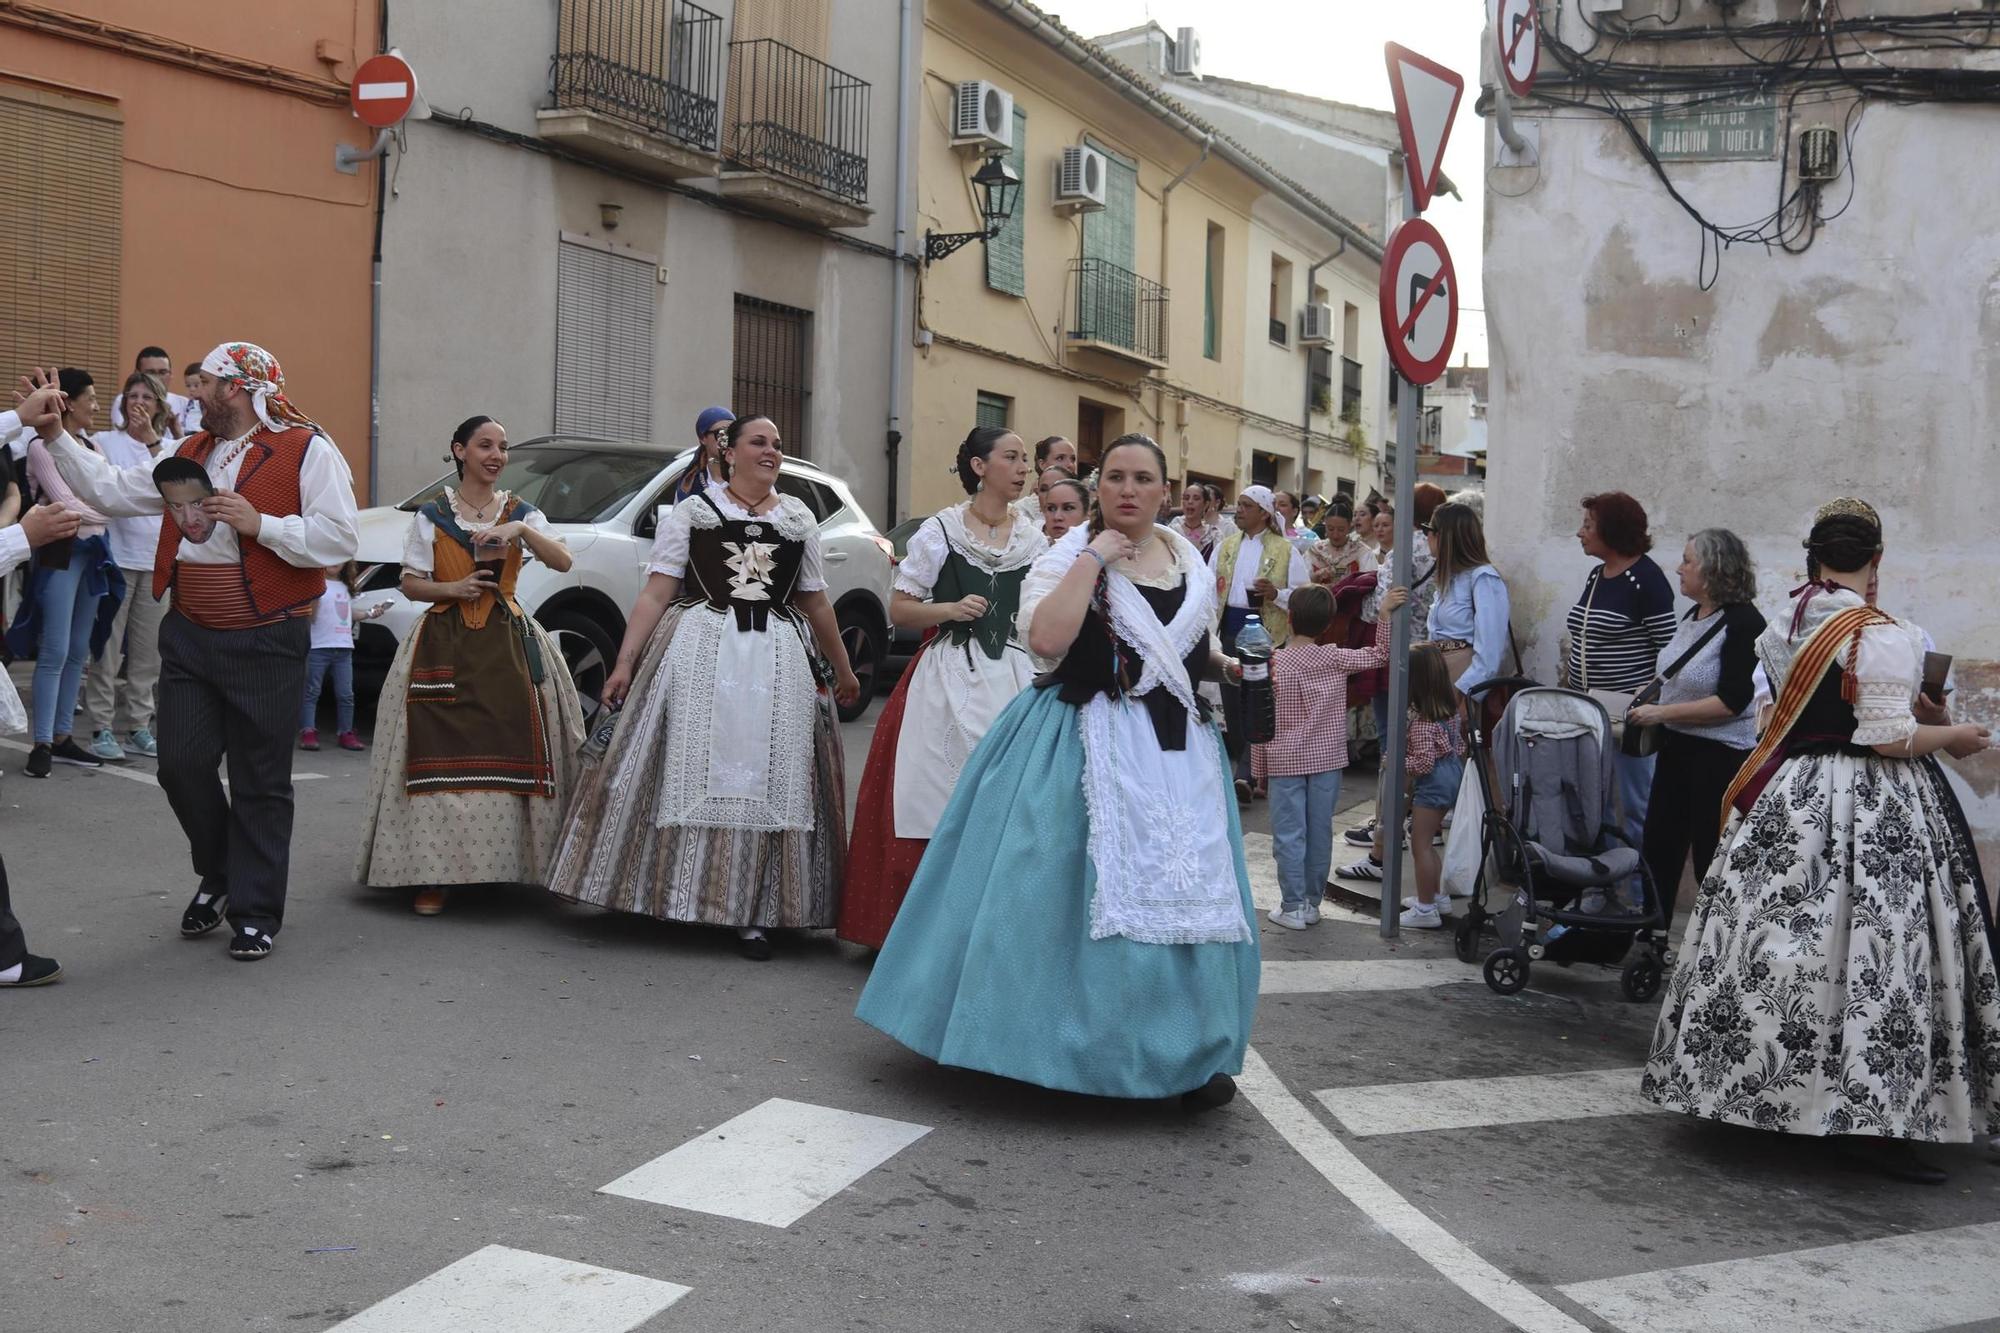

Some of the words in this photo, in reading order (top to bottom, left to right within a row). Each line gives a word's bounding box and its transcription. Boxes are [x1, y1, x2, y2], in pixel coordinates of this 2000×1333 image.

[1700, 111, 1746, 125] PINTOR
[1659, 130, 1709, 153] JOAQUIN
[1720, 129, 1764, 152] TUDELA
